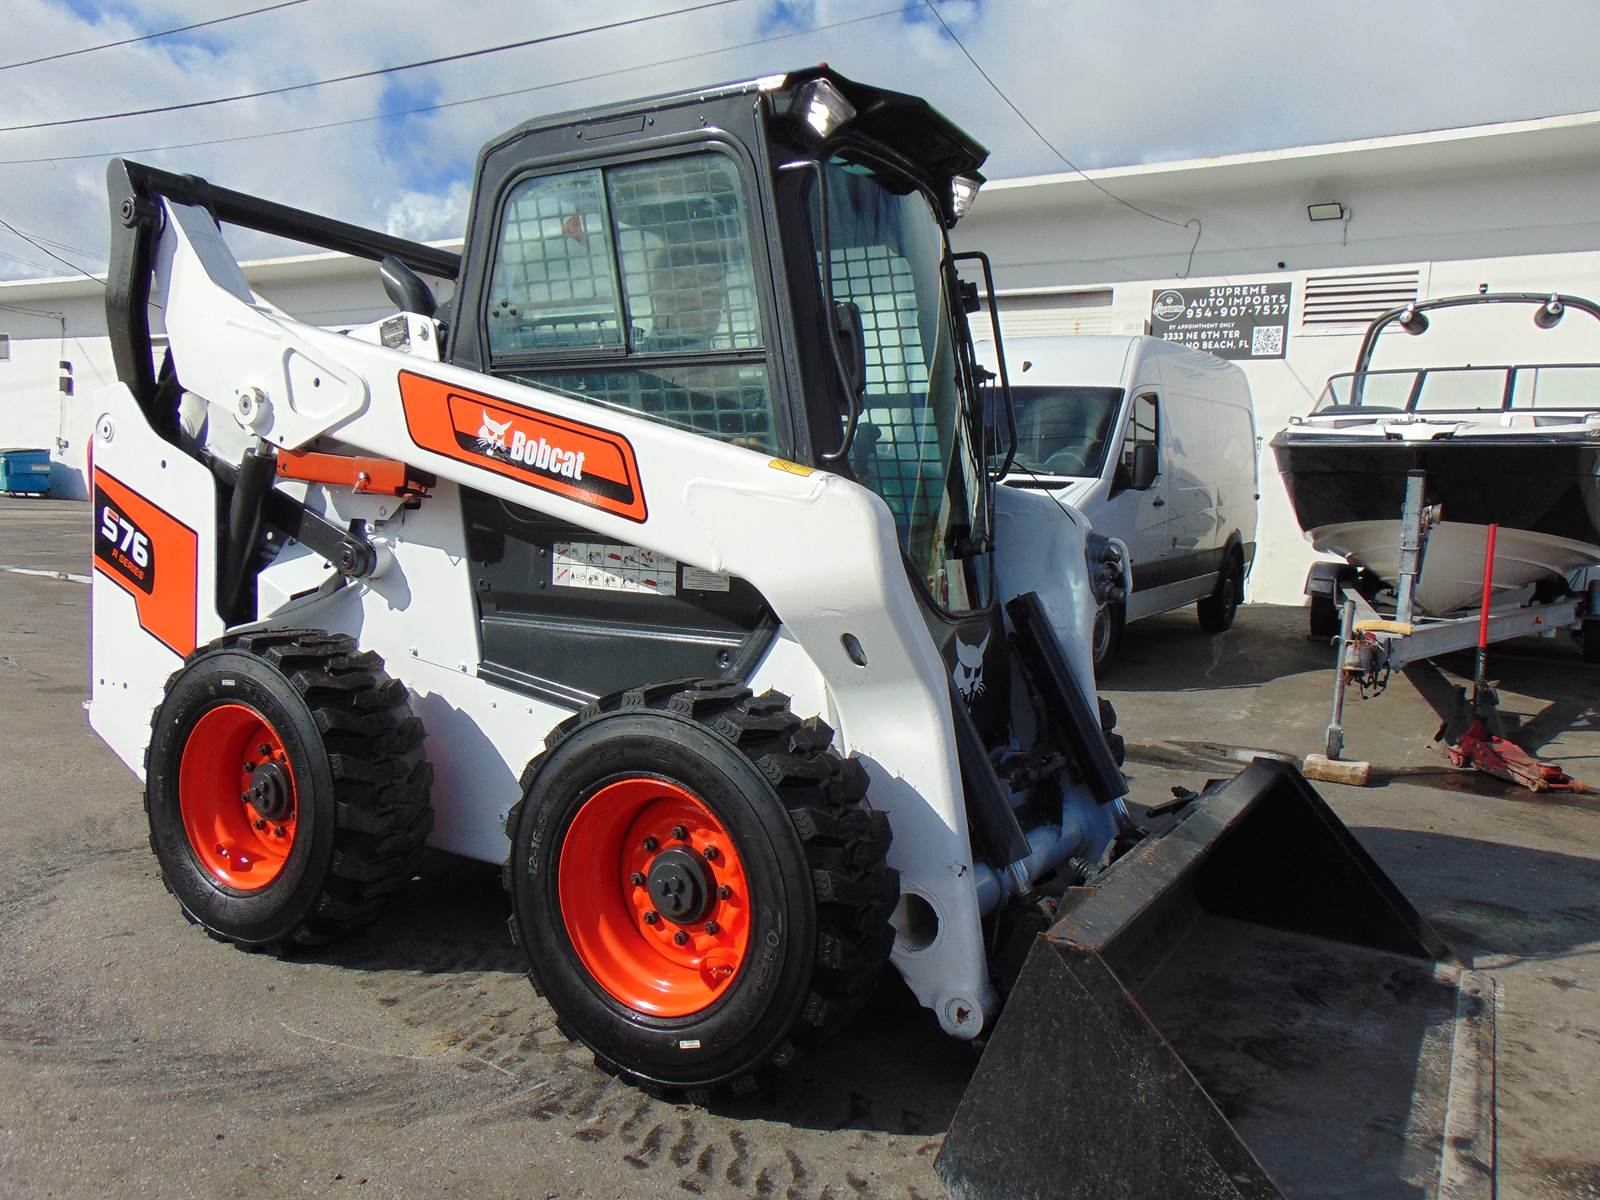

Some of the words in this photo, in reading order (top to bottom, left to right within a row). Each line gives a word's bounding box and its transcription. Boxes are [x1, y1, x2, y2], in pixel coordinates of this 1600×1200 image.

[1210, 286, 1267, 297] SUPREME
[1190, 298, 1224, 308] AUTO
[1229, 294, 1286, 306] IMPORTS
[1163, 332, 1184, 340] 3333
[1186, 332, 1198, 340] NE
[1200, 331, 1220, 340] 6TH
[1223, 330, 1240, 339] TER
[1239, 340, 1250, 348] FL
[510, 430, 585, 481] Bobcat
[101, 506, 149, 568] S76
[111, 548, 118, 559] R
[119, 554, 144, 580] SERIES
